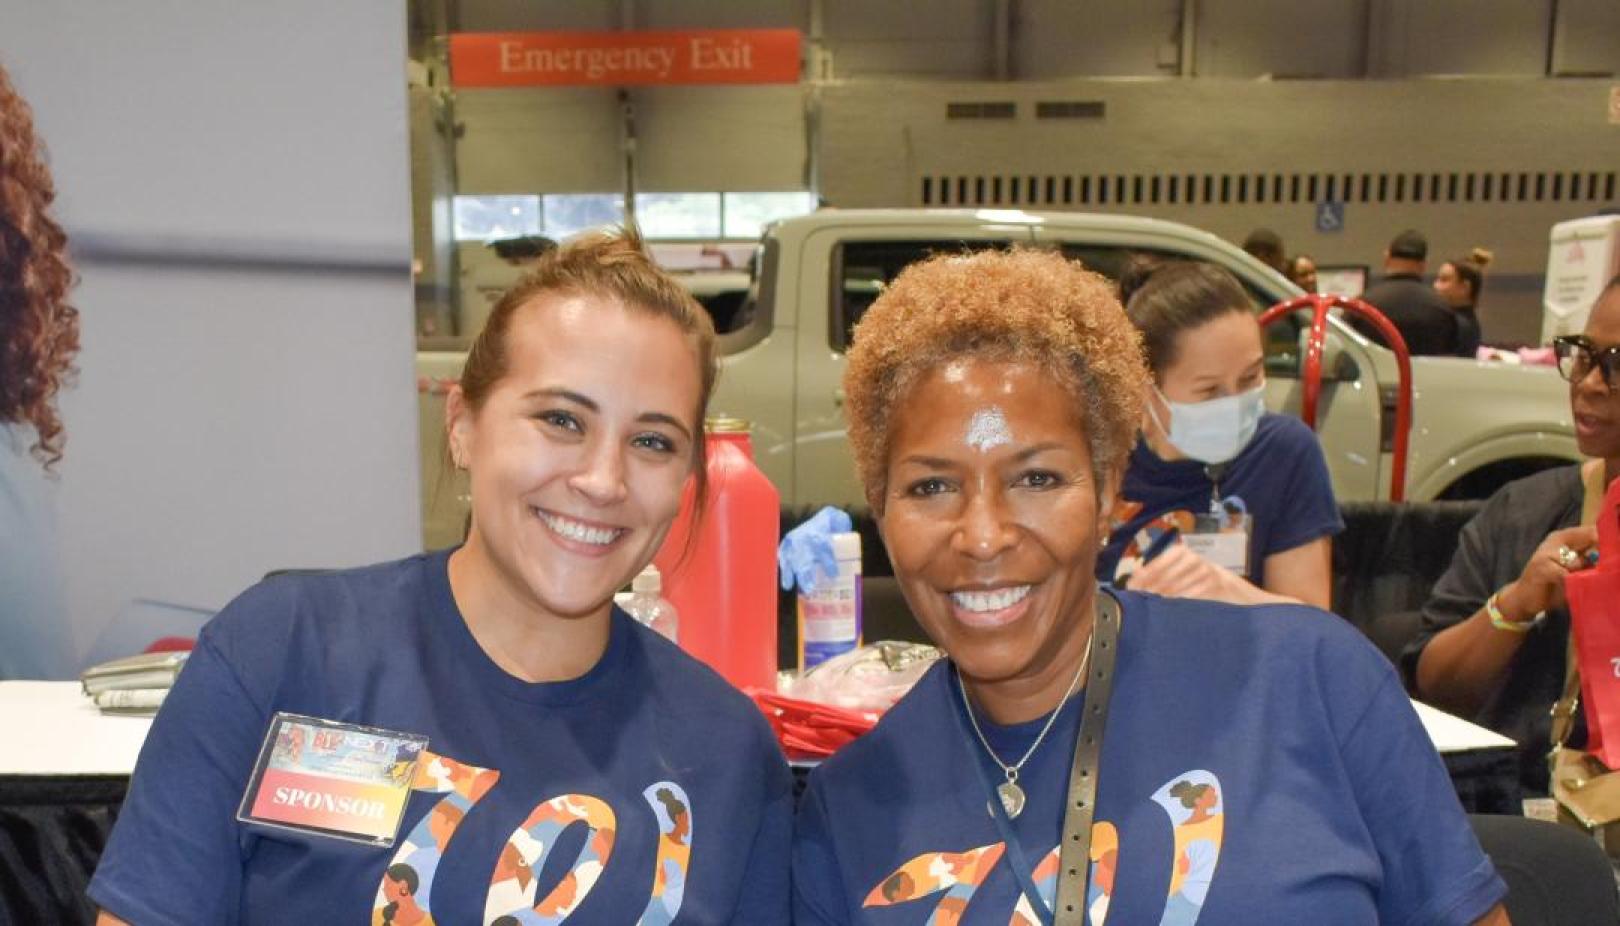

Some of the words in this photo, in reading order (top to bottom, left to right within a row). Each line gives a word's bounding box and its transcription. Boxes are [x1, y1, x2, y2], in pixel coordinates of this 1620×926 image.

[500, 40, 675, 78] Emergency
[690, 38, 752, 69] Exit
[273, 787, 384, 818] SPONSOR
